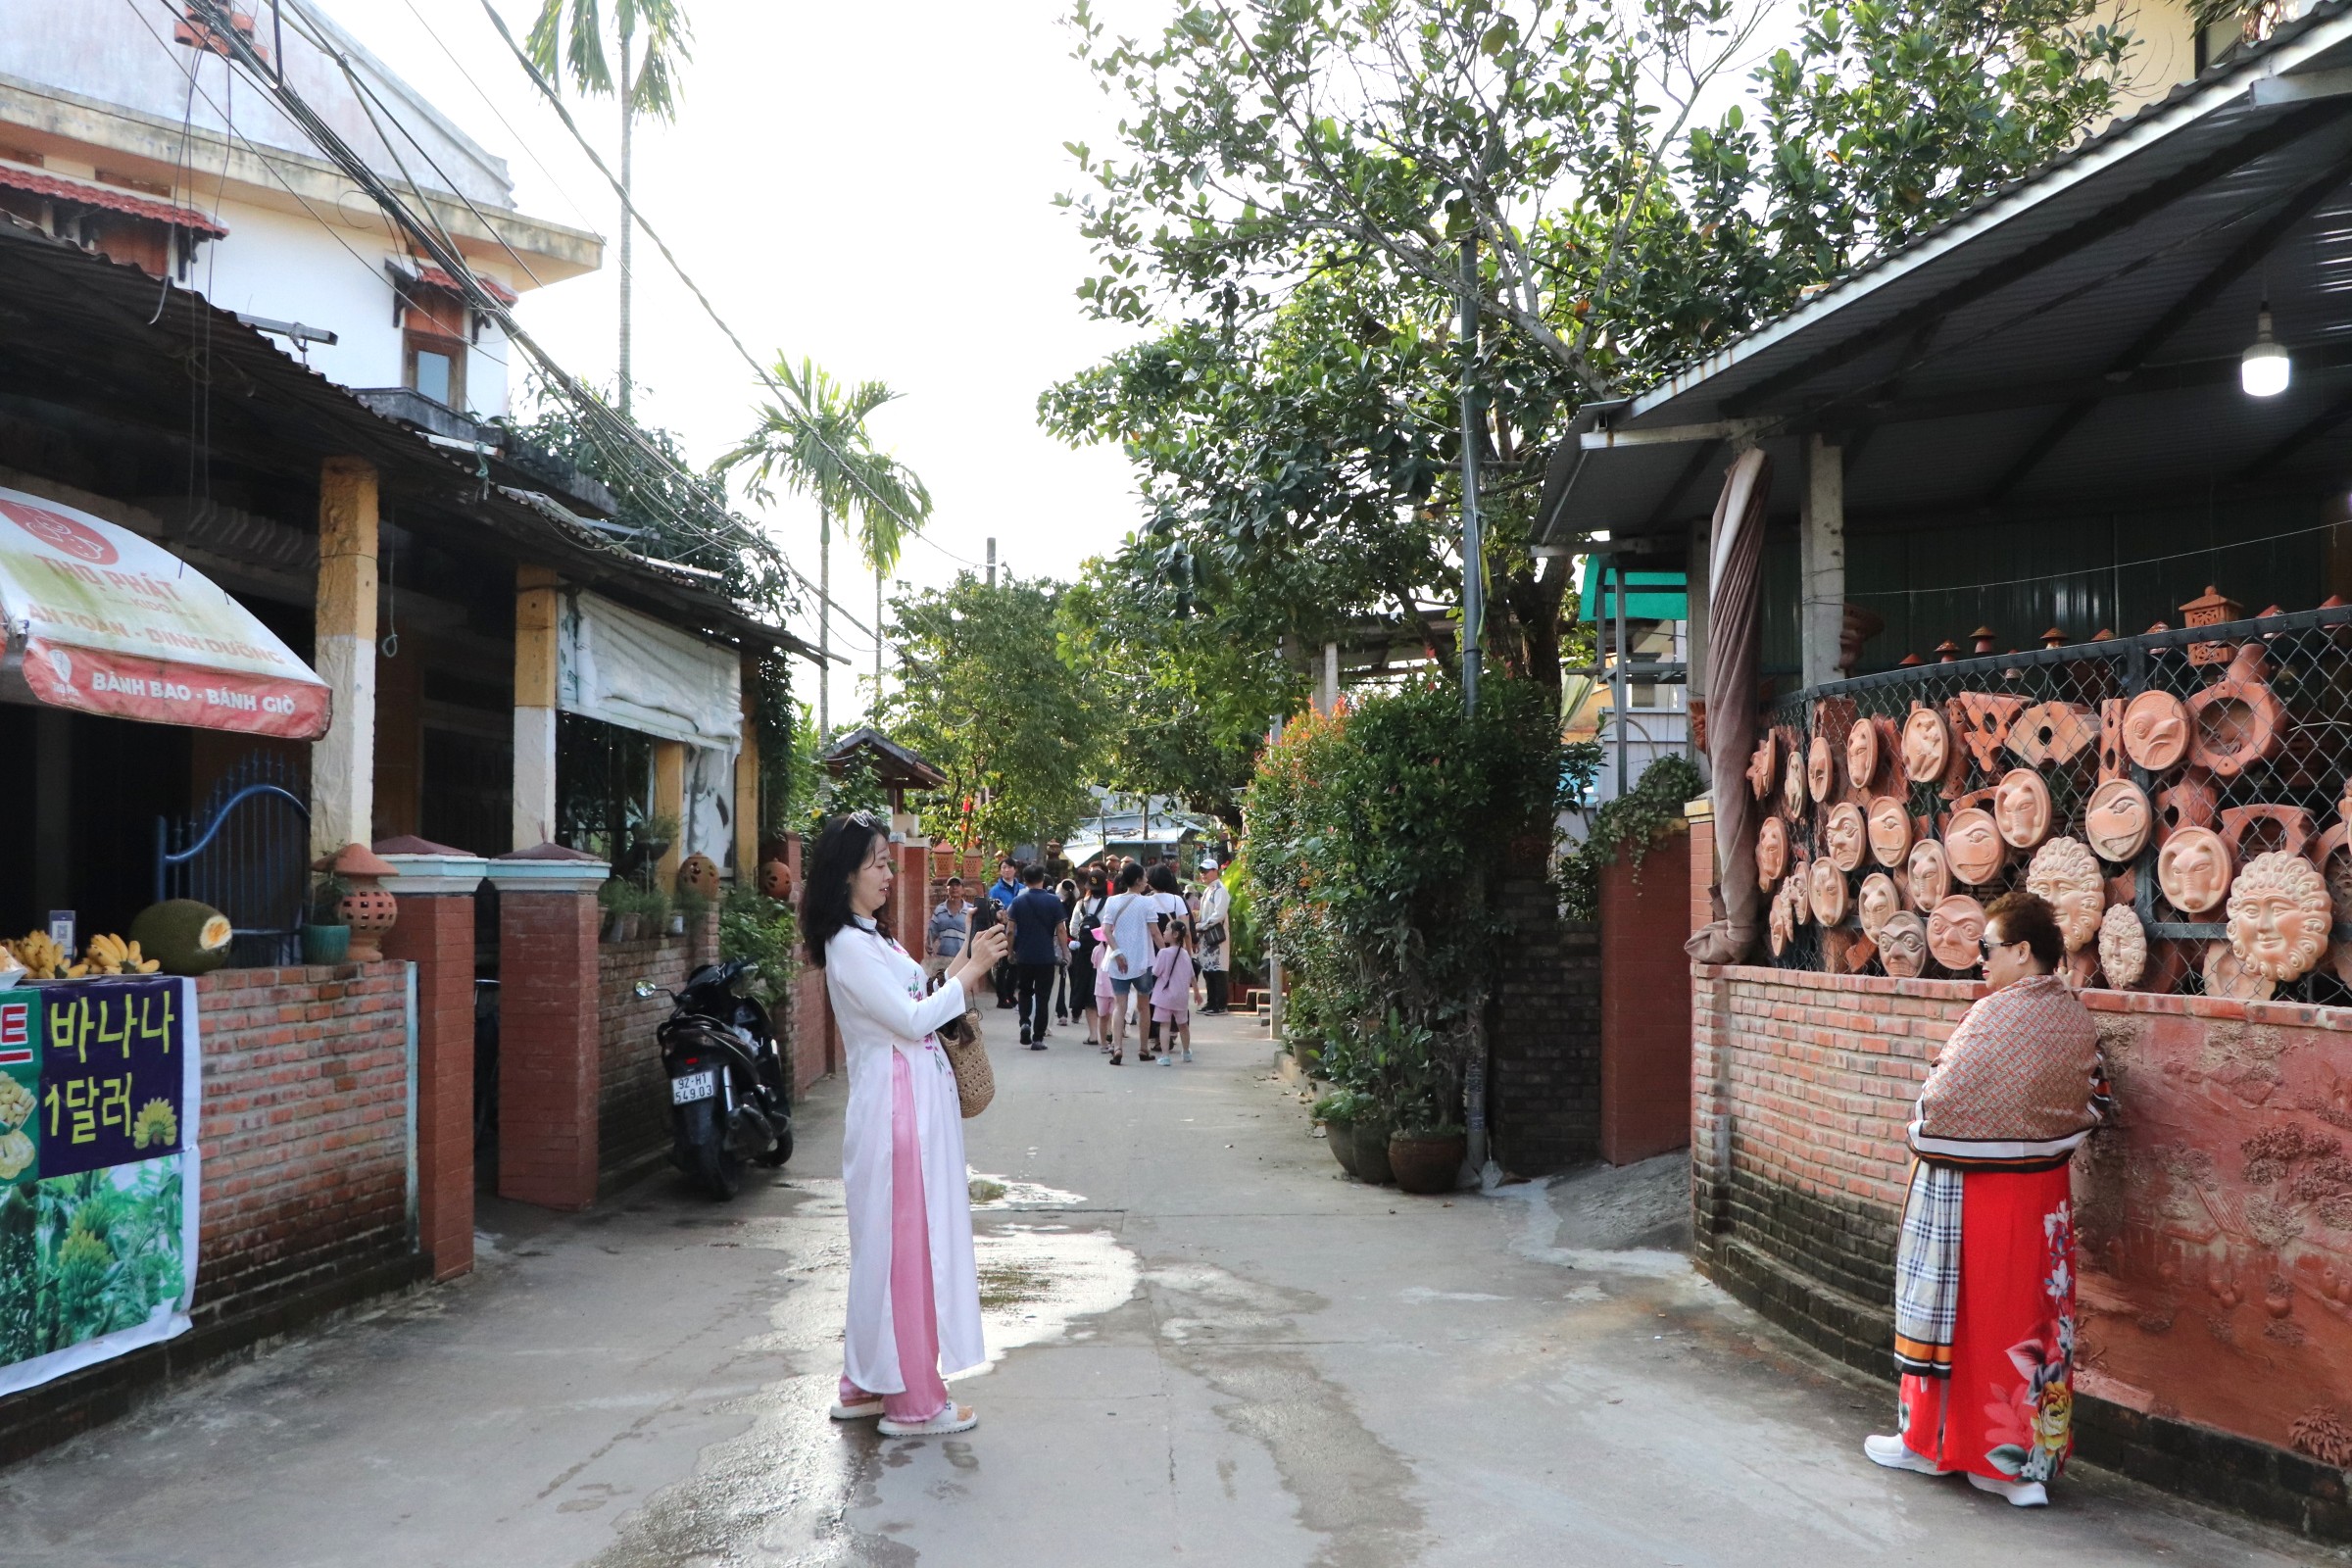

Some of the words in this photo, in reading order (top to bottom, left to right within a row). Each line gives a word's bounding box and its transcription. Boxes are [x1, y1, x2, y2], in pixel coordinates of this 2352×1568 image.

[28, 604, 63, 624] AN
[145, 627, 204, 651] DINH
[92, 671, 145, 696] BÁNH
[149, 680, 191, 701] BAO
[206, 686, 257, 710] BÁNH
[262, 694, 296, 714] GIÒ
[50, 991, 175, 1063] 바나나
[675, 1085, 712, 1102] 549.03
[678, 1073, 707, 1089] 92-H1
[44, 1072, 132, 1144] 1달러
